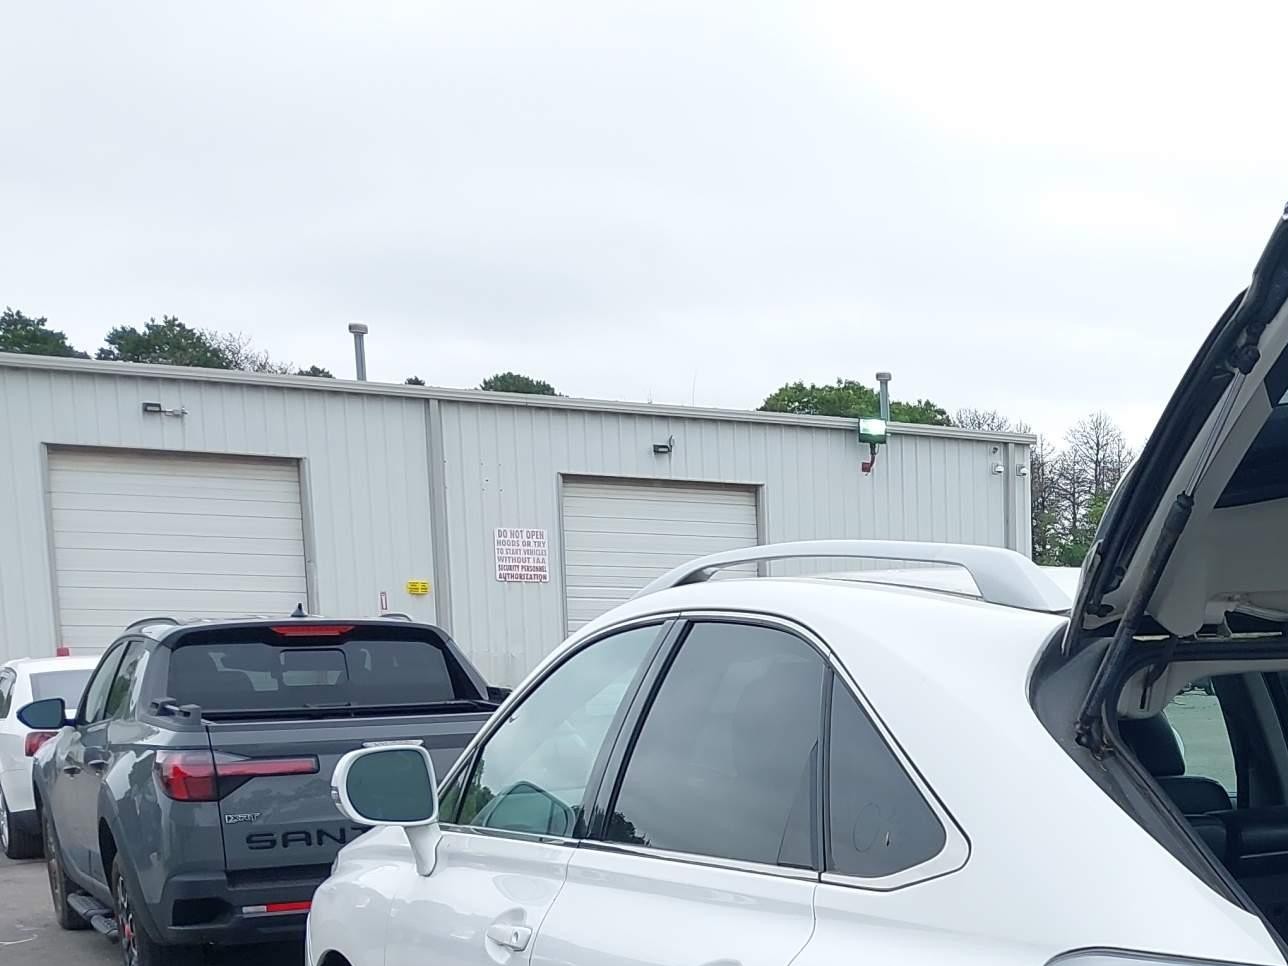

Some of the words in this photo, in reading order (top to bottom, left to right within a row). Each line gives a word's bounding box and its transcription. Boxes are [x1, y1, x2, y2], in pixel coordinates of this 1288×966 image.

[497, 529, 508, 539] DO
[509, 530, 524, 539] NOT
[526, 531, 544, 540] OPEN
[496, 539, 520, 547] HOODS
[533, 540, 546, 548] TRY
[496, 548, 504, 556] TO
[505, 548, 522, 556] START
[497, 556, 531, 564] WITHOUT
[498, 564, 520, 572] SECURITY
[521, 564, 547, 572] PERSONNEL
[498, 572, 547, 581] AUTHORIZATION
